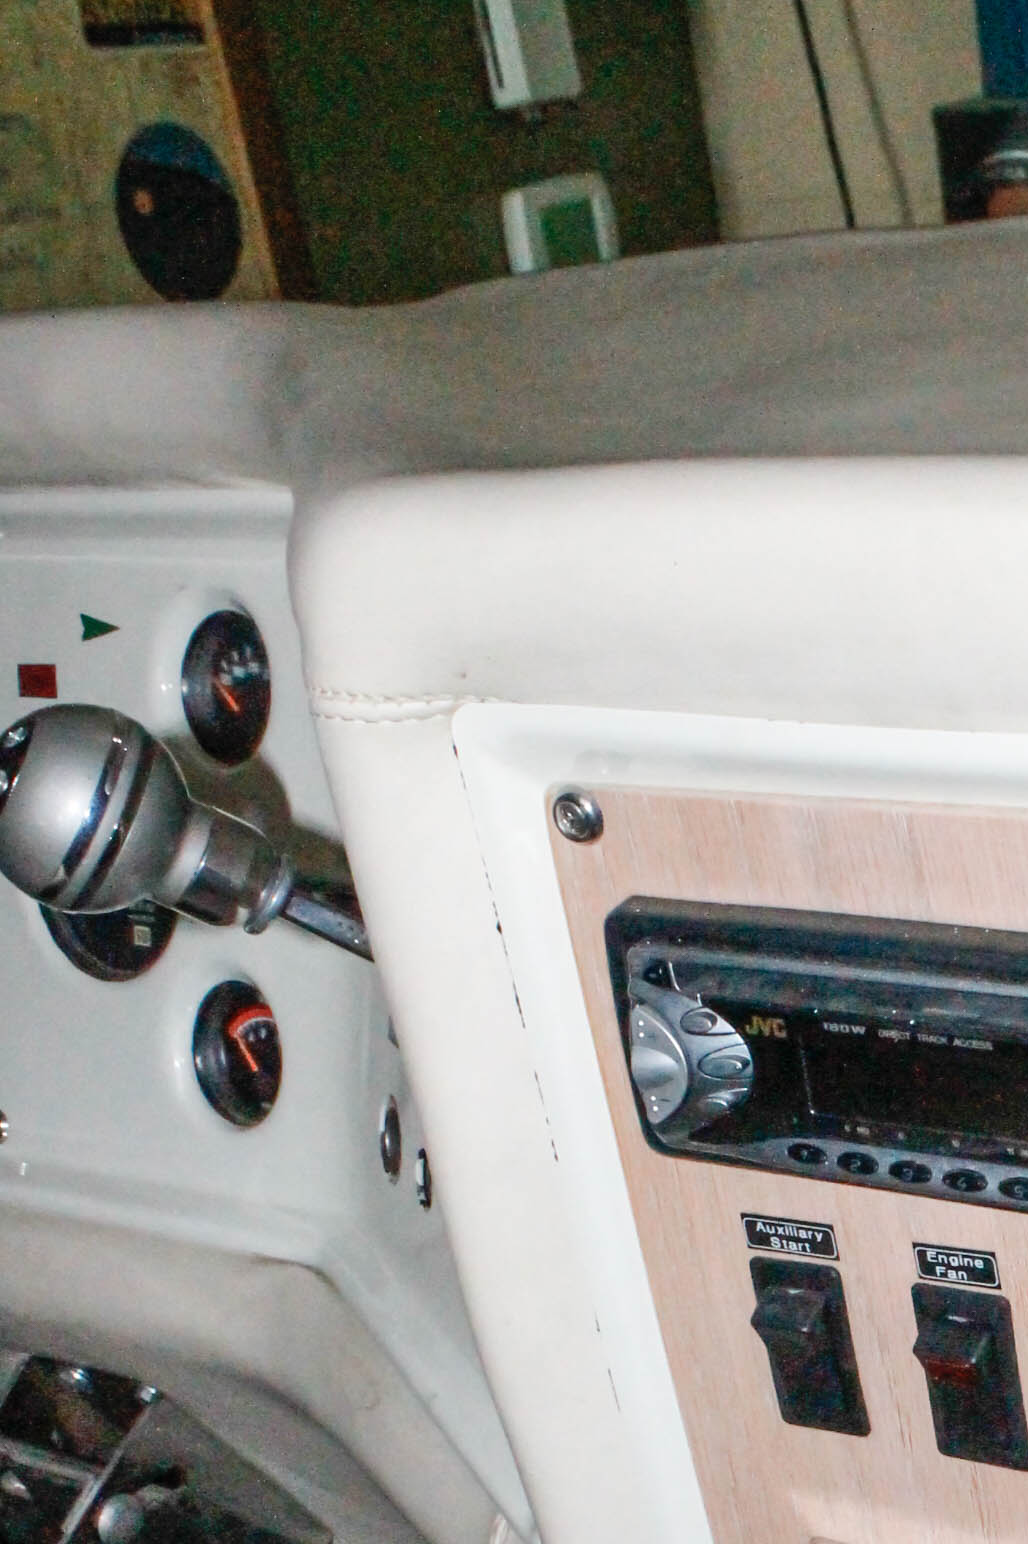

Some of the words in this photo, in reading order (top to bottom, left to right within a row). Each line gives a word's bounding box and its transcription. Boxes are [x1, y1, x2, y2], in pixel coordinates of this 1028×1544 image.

[745, 1015, 788, 1038] JVC
[756, 1221, 823, 1242] Auxiliary
[769, 1236, 811, 1252] Start
[926, 1250, 985, 1269] Engine
[935, 1265, 968, 1281] Fan
